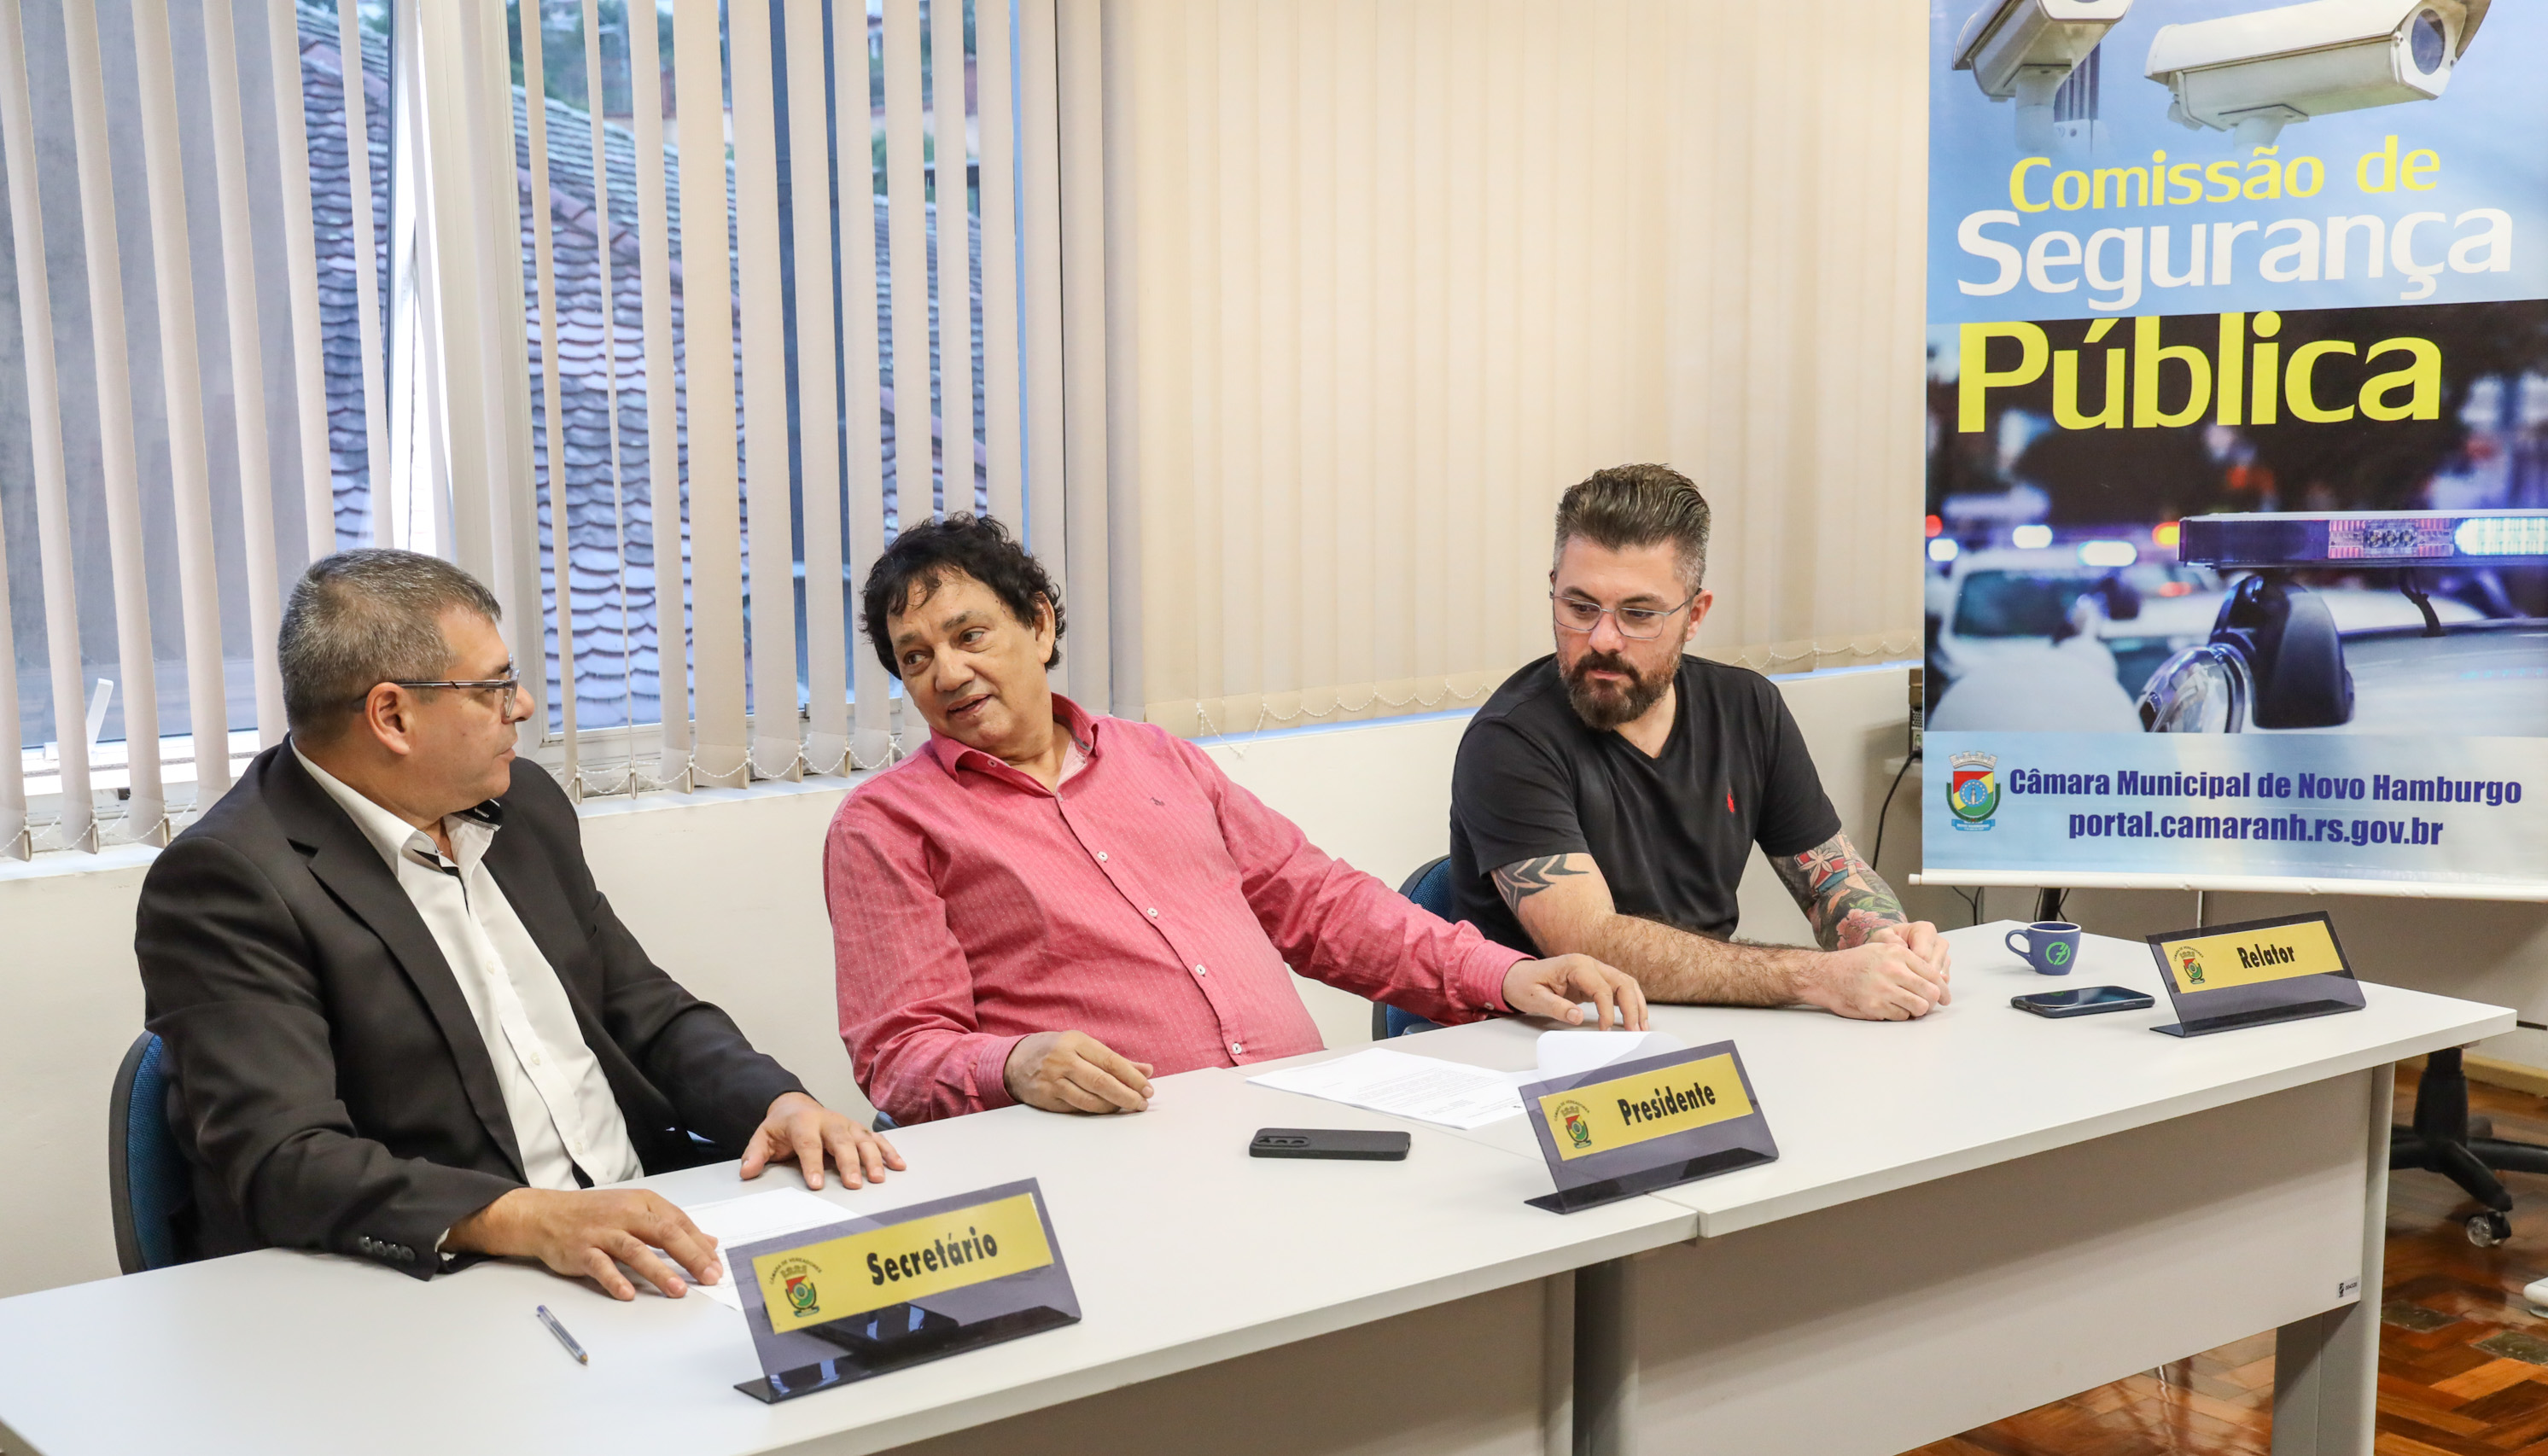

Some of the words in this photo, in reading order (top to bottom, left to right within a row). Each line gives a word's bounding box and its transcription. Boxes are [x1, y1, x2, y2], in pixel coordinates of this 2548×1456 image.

[2009, 144, 2324, 213] Comissão
[2356, 134, 2440, 195] de
[1956, 207, 2514, 311] Segurança
[1957, 310, 2442, 434] Pública
[2009, 768, 2109, 795] Câmara
[2117, 770, 2250, 800] Municipal
[2258, 772, 2291, 798] de
[2298, 772, 2365, 800] Novo
[2372, 774, 2522, 807] Hamburgo
[2068, 811, 2444, 847] portal.camaranh.rs.gov.br
[2236, 943, 2295, 969] Relator
[1617, 1081, 1716, 1126] Presidente
[866, 1226, 998, 1286] Secretário
